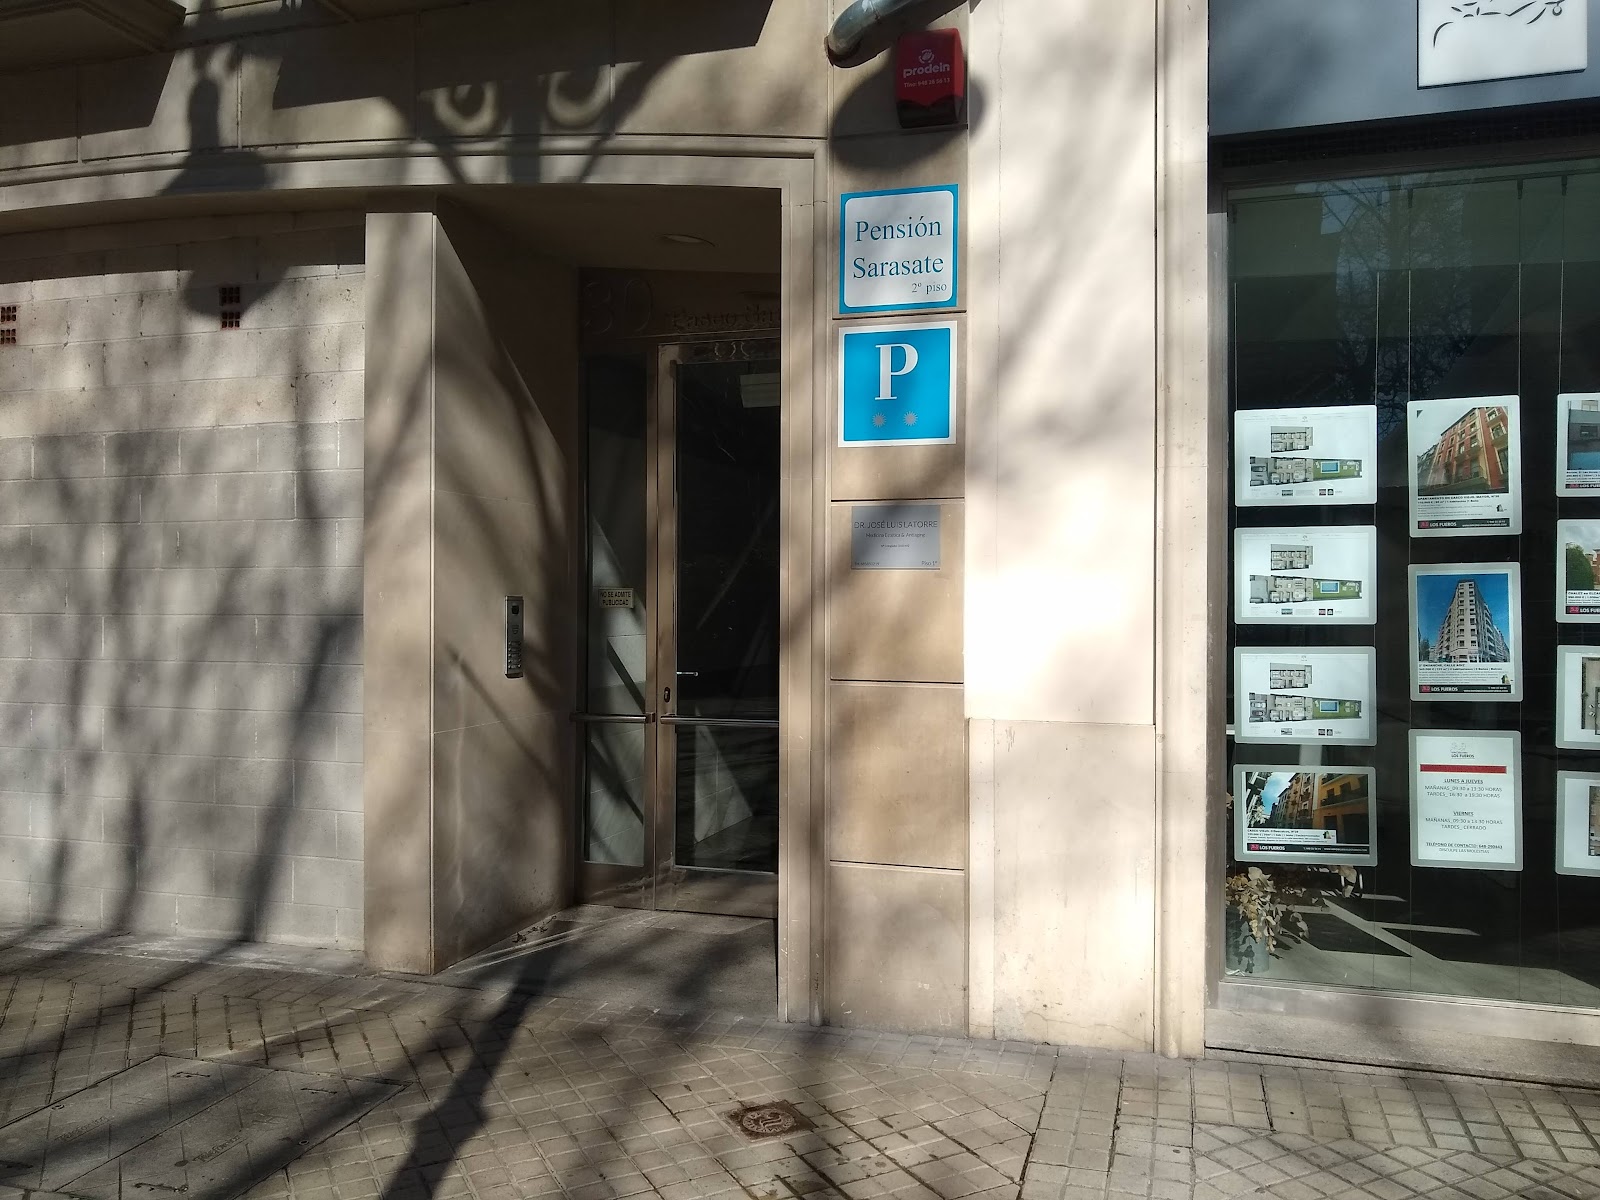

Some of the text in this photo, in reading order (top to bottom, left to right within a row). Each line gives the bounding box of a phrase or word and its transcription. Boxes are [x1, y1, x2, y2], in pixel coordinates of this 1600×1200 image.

[902, 62, 950, 78] prodein
[854, 215, 942, 242] Pensión
[853, 256, 944, 279] Sarasate
[926, 281, 947, 294] piso
[874, 343, 919, 401] P
[867, 520, 885, 529] JOSÉ
[886, 521, 902, 529] LUIS
[903, 520, 938, 528] LATORRE
